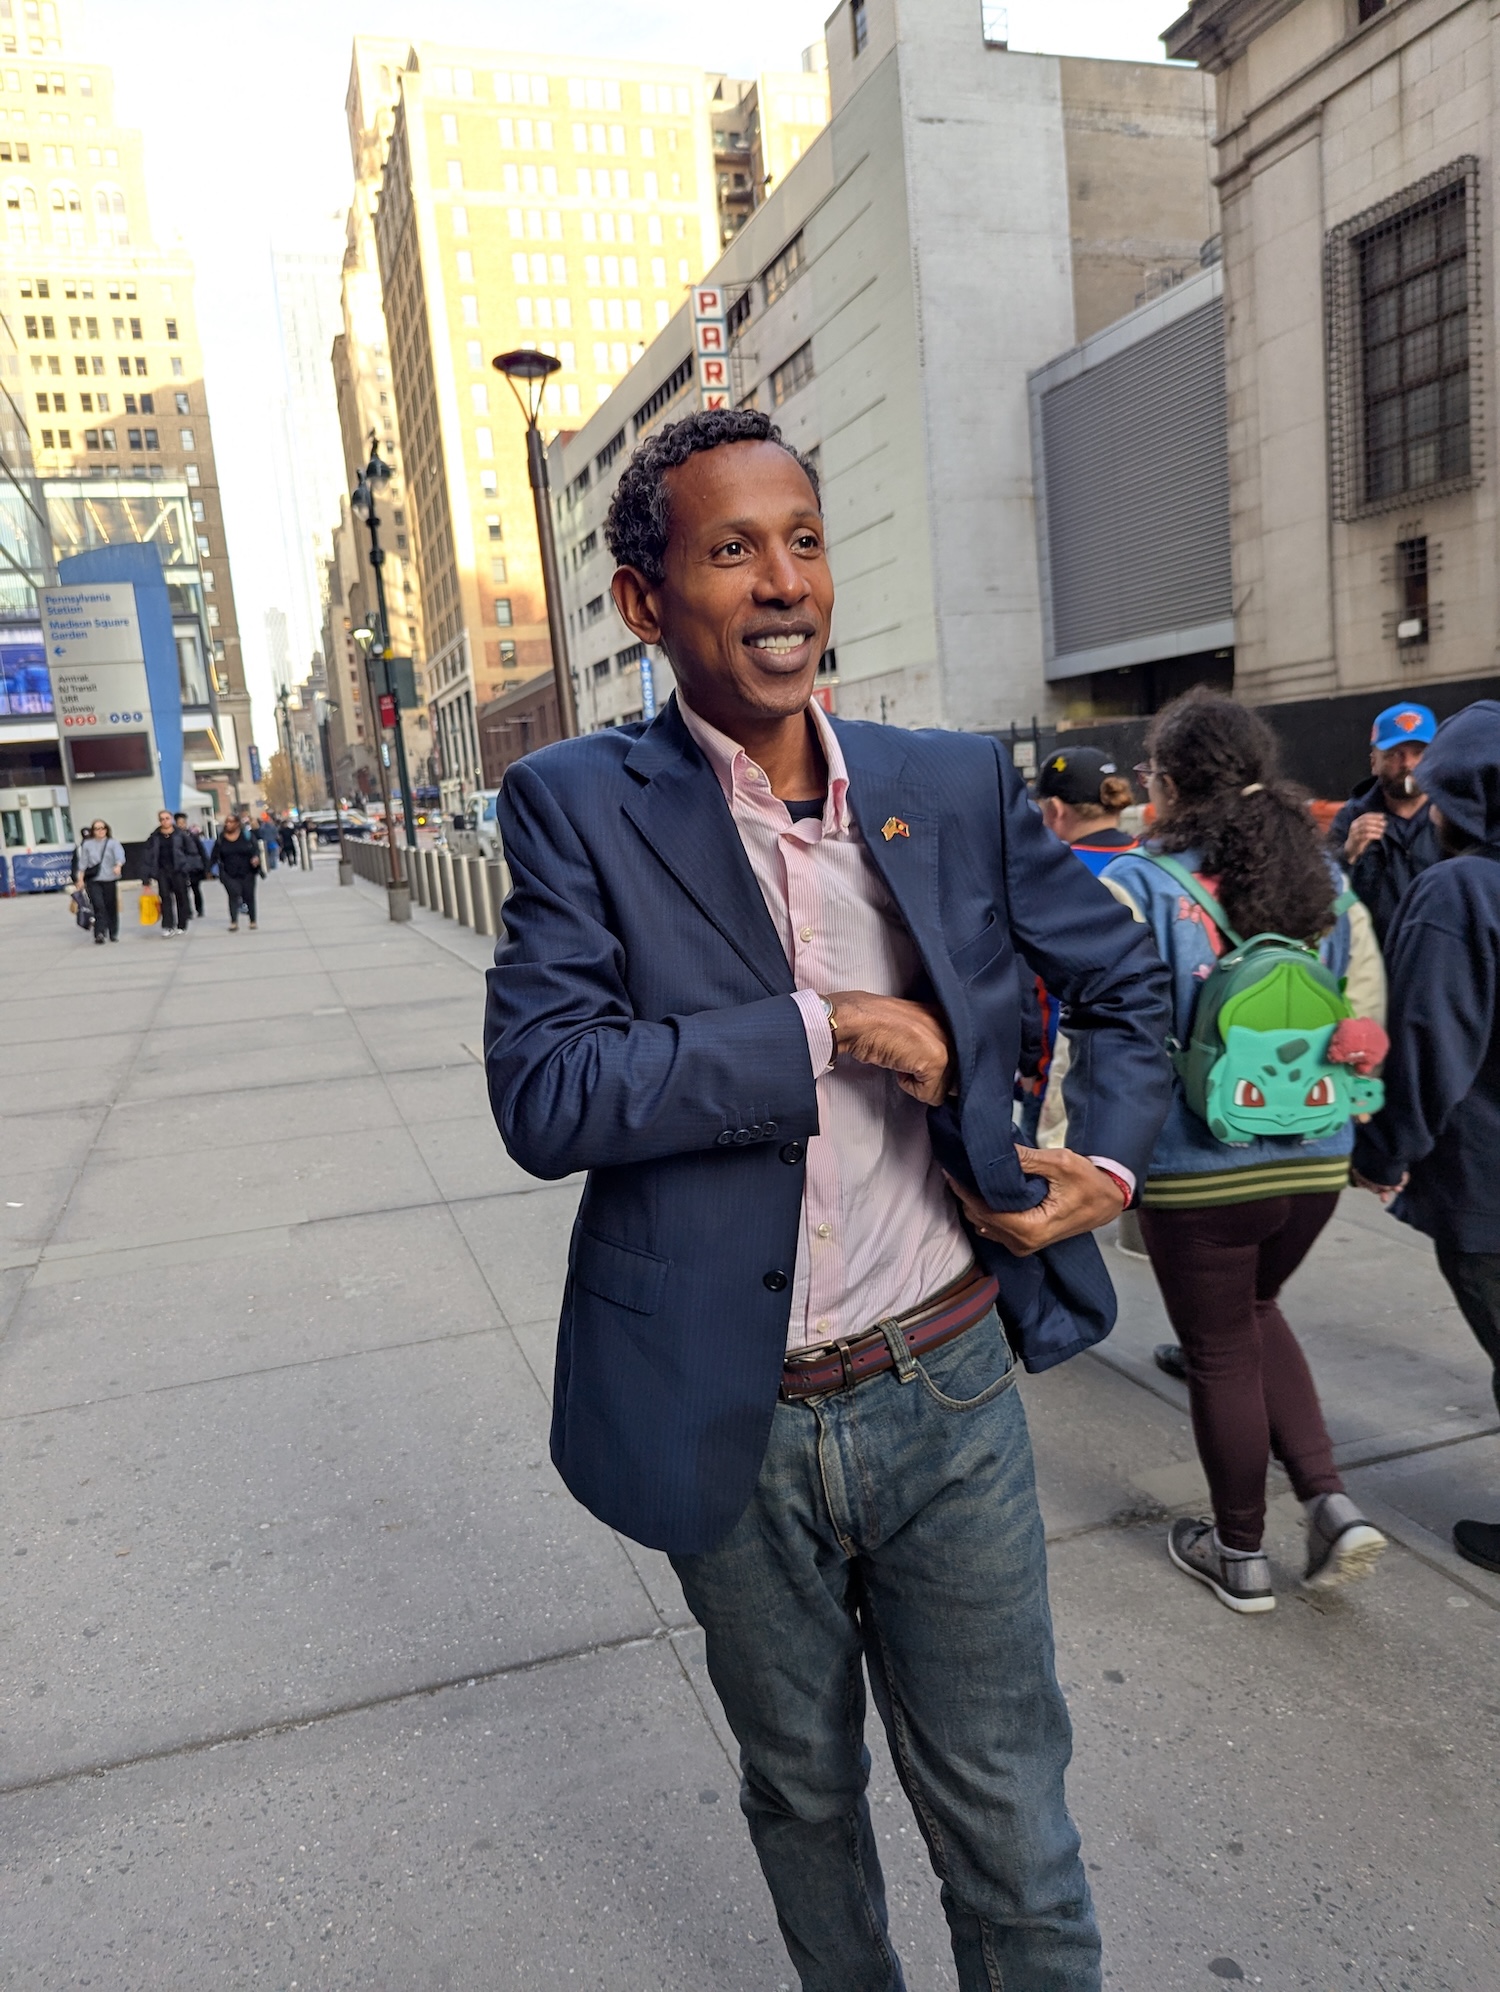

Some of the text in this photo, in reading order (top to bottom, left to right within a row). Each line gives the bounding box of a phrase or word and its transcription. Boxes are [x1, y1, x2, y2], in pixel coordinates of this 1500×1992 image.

[45, 593, 111, 605] Pennsylvania
[47, 606, 83, 615] Station
[49, 619, 129, 630] Madison Square
[51, 631, 88, 640] Garden
[58, 674, 89, 682] Amtrak
[71, 684, 97, 692] Transit
[62, 705, 95, 714] Subway
[32, 876, 56, 887] THE
